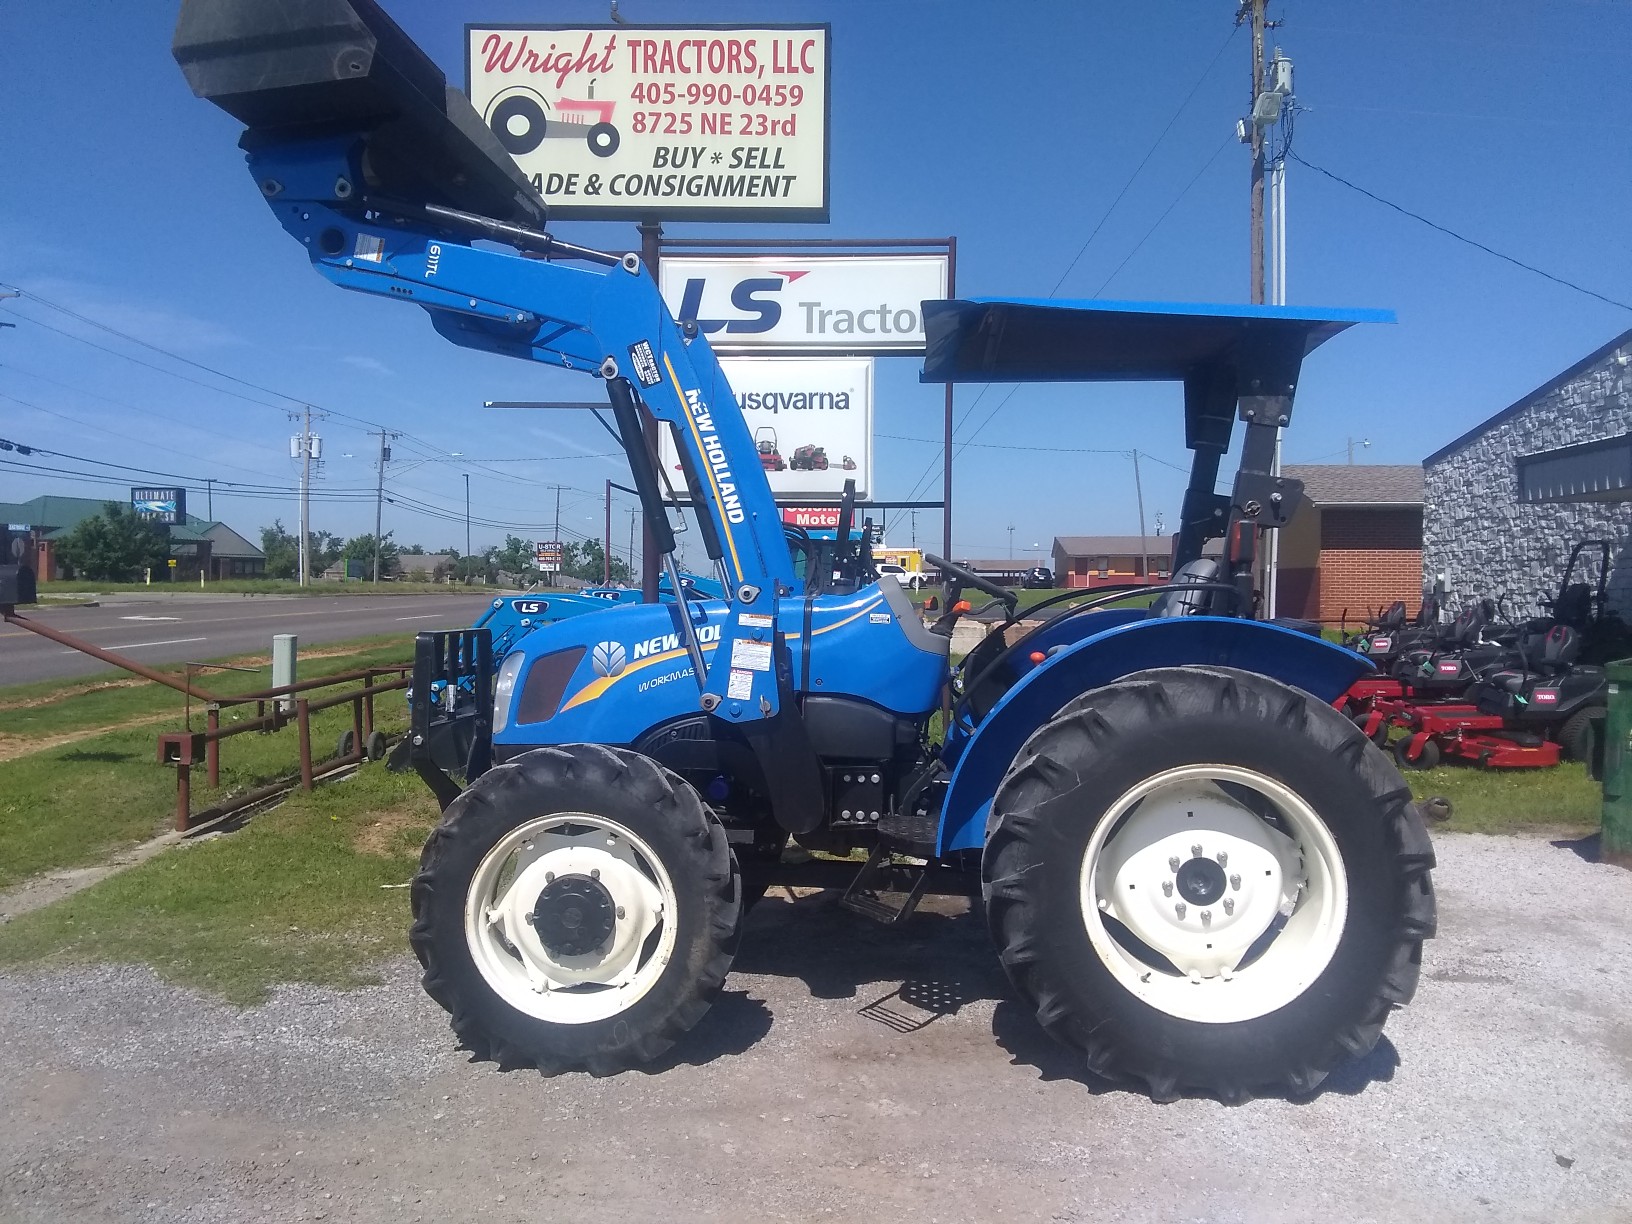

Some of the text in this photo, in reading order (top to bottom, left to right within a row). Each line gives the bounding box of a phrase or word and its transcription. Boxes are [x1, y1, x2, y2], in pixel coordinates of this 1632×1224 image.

[481, 32, 815, 89] Wright TRACTORS, LLC
[630, 82, 804, 107] 405-990-0459
[632, 111, 796, 137] 8725 NE 23rd
[653, 146, 785, 169] BUY SELL
[523, 172, 797, 197] ADE & CONSIGNMENT
[425, 245, 441, 278] 611TL
[678, 278, 784, 334] LS
[734, 391, 850, 414] usqvarna
[685, 388, 744, 524] NEW HOLLAND
[135, 491, 174, 500] ULTIMATE
[521, 601, 539, 613] LS
[633, 632, 682, 660] NEW
